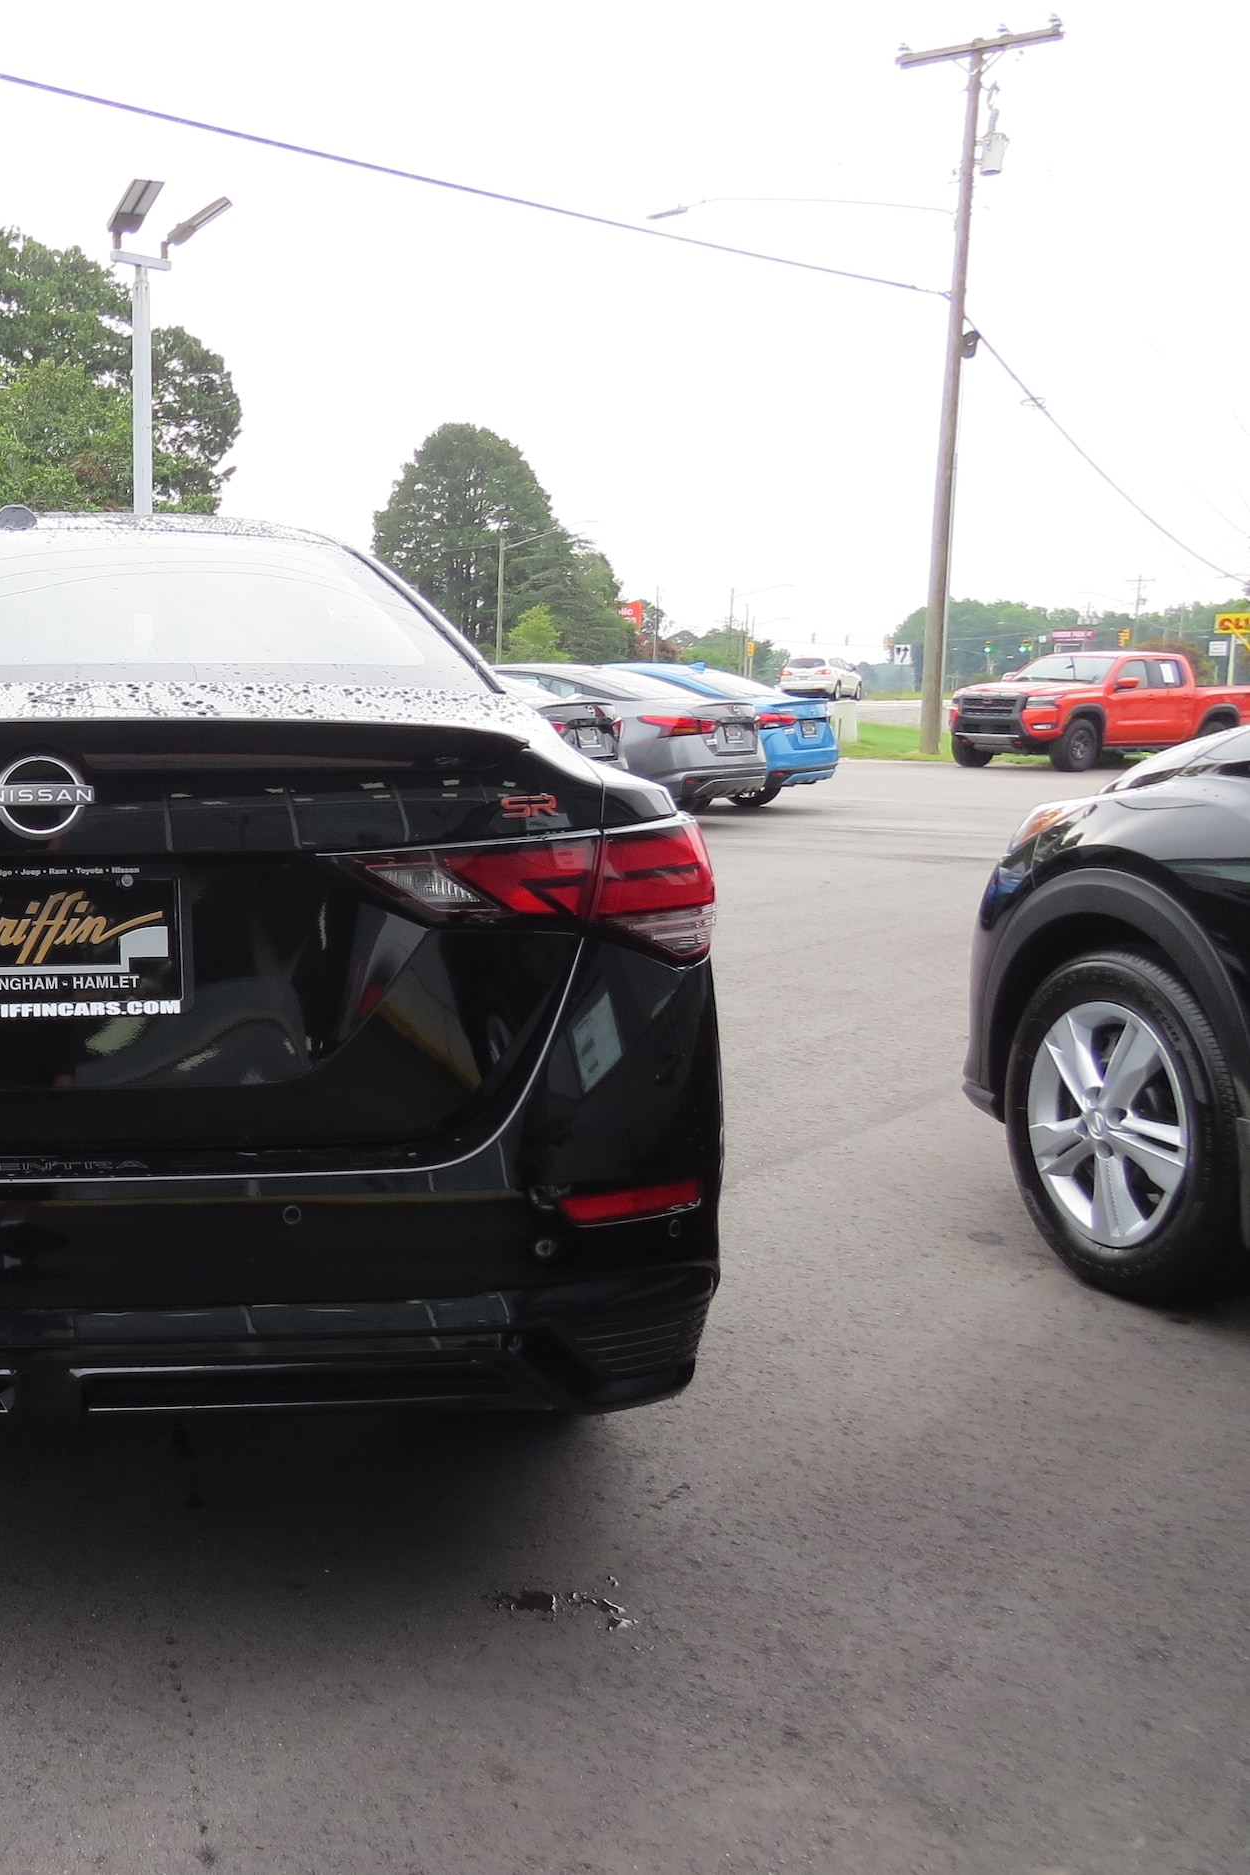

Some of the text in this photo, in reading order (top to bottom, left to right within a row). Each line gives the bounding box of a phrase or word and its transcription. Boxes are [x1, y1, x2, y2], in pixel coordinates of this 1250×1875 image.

[501, 793, 558, 818] SR
[21, 868, 41, 877] Jeep
[75, 867, 104, 875] Toyota
[72, 975, 140, 989] HAMLET
